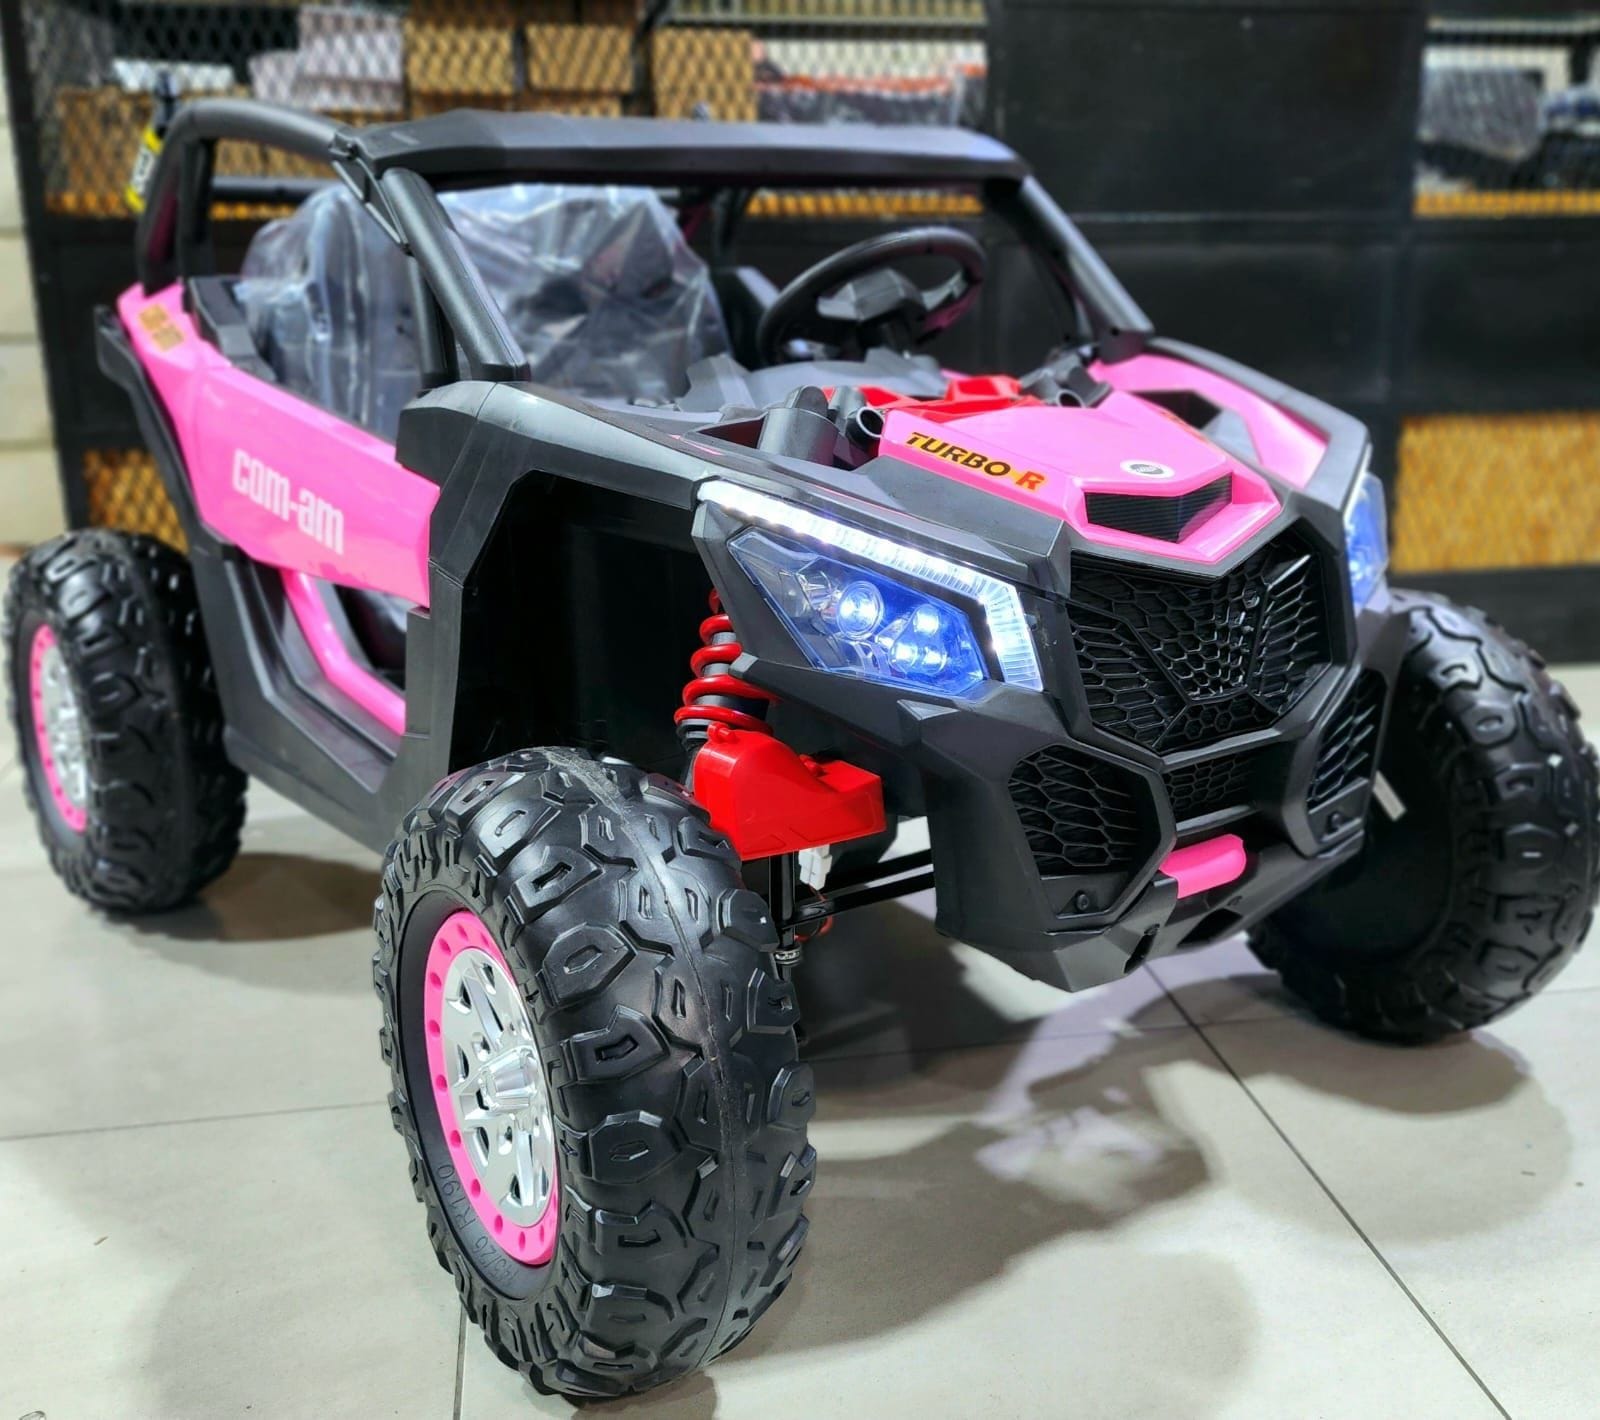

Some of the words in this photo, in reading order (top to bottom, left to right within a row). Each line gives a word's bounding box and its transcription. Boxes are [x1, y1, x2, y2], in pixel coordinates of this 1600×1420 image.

[906, 431, 1011, 476] TURBO
[1015, 471, 1045, 490] R
[437, 1164, 476, 1230] R190
